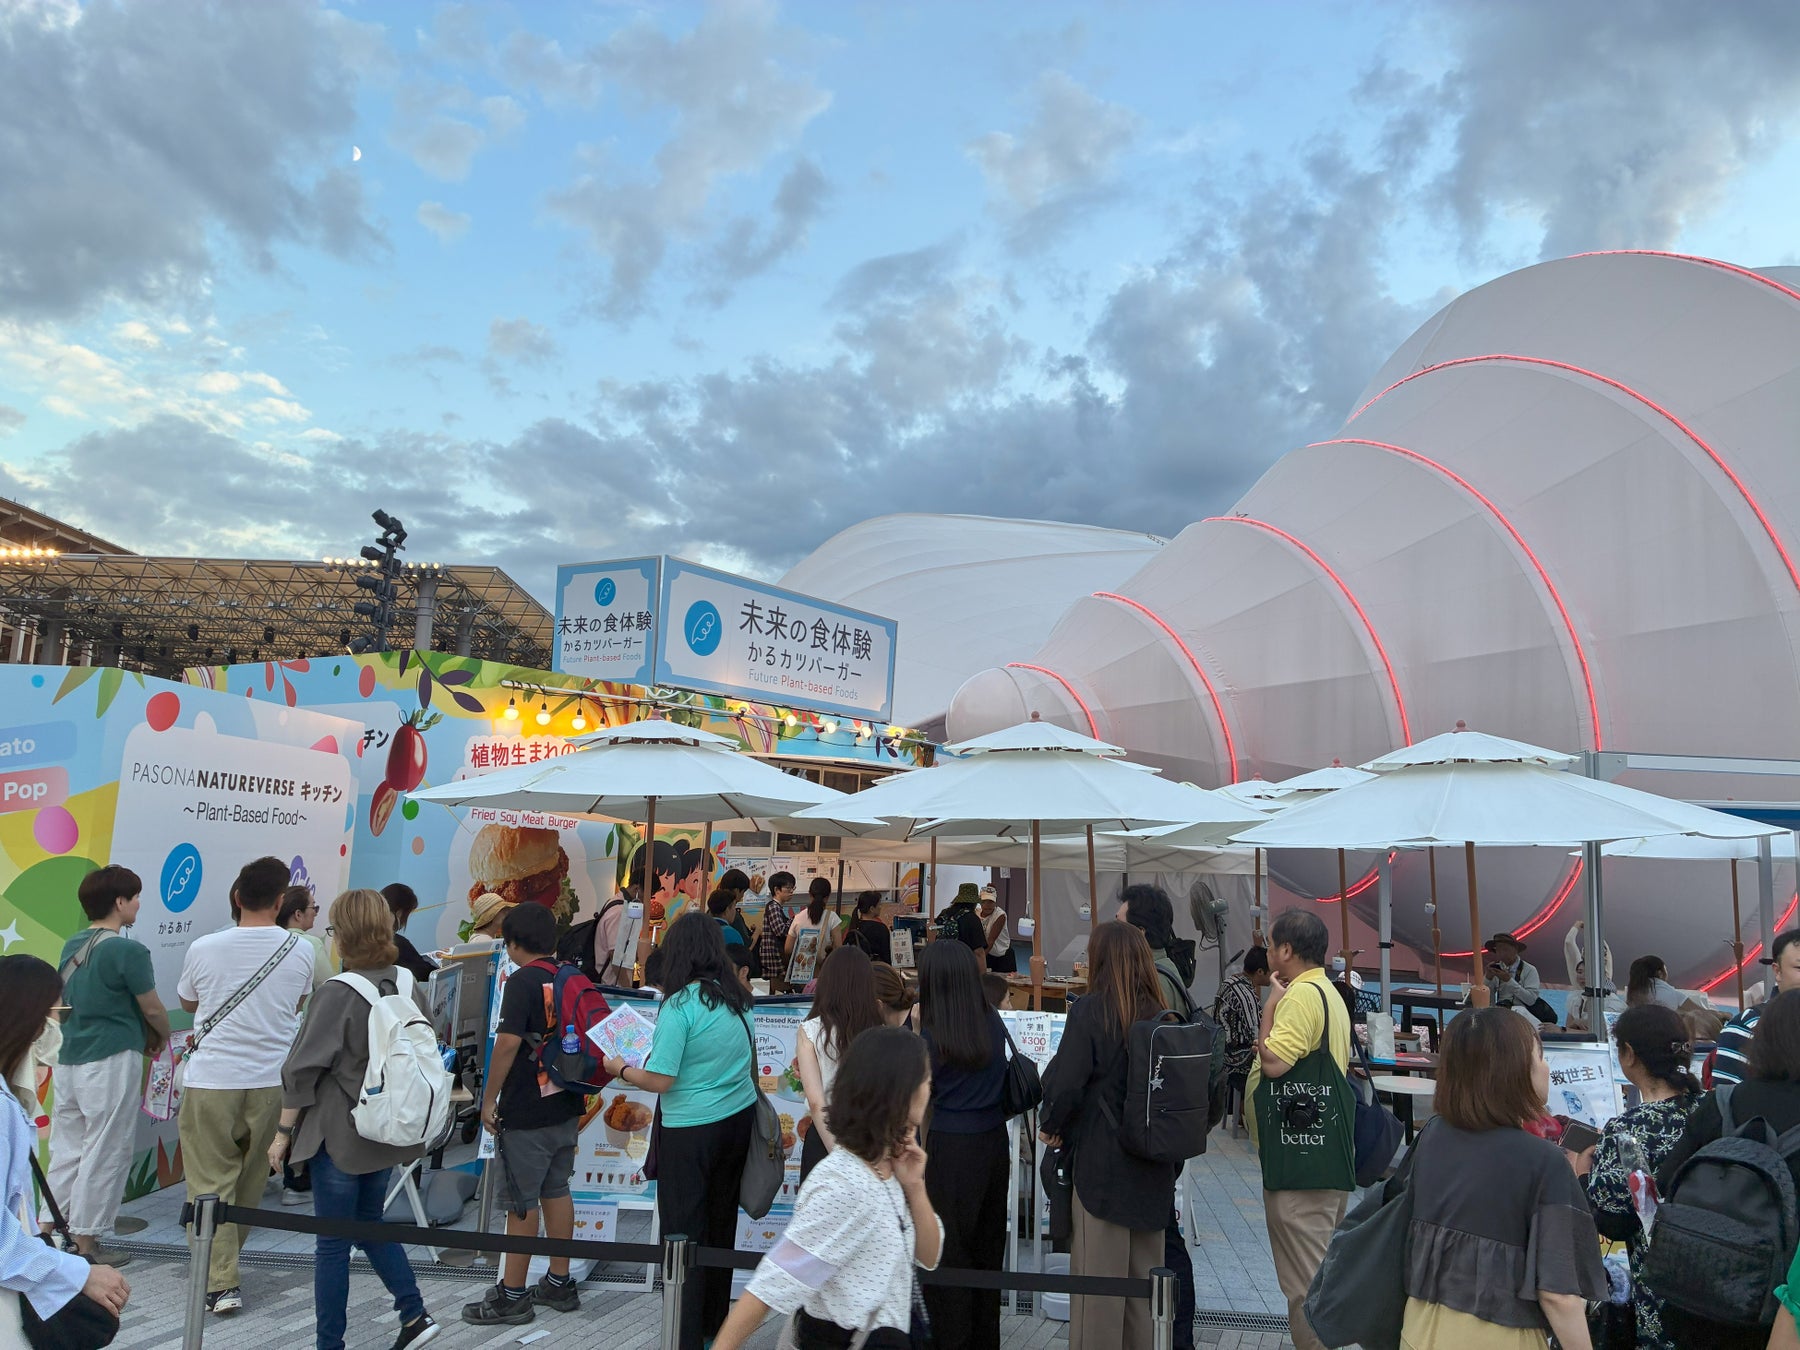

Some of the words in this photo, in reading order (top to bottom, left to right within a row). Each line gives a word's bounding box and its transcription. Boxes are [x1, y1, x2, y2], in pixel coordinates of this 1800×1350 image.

[557, 611, 653, 636] 未来の食体験
[740, 599, 872, 661] 未来の食体験
[563, 637, 643, 652] かるカツバーガー
[583, 653, 621, 663] Plant-based
[748, 642, 862, 681] かるカツバーガー
[748, 668, 778, 685] Future
[781, 674, 833, 695] Plant-based
[835, 685, 859, 700] Foods
[4, 781, 48, 801] Pop
[300, 781, 343, 803] キッチン
[471, 808, 496, 821] Fried
[500, 811, 518, 825] Soy
[521, 814, 544, 825] Meat
[548, 816, 578, 829] Burger
[158, 920, 192, 935] かるあげ
[1022, 1036, 1047, 1046] ¥300
[1550, 1065, 1605, 1086] 救世主！
[1270, 1081, 1332, 1096] LfeWear
[1280, 1128, 1326, 1146] better
